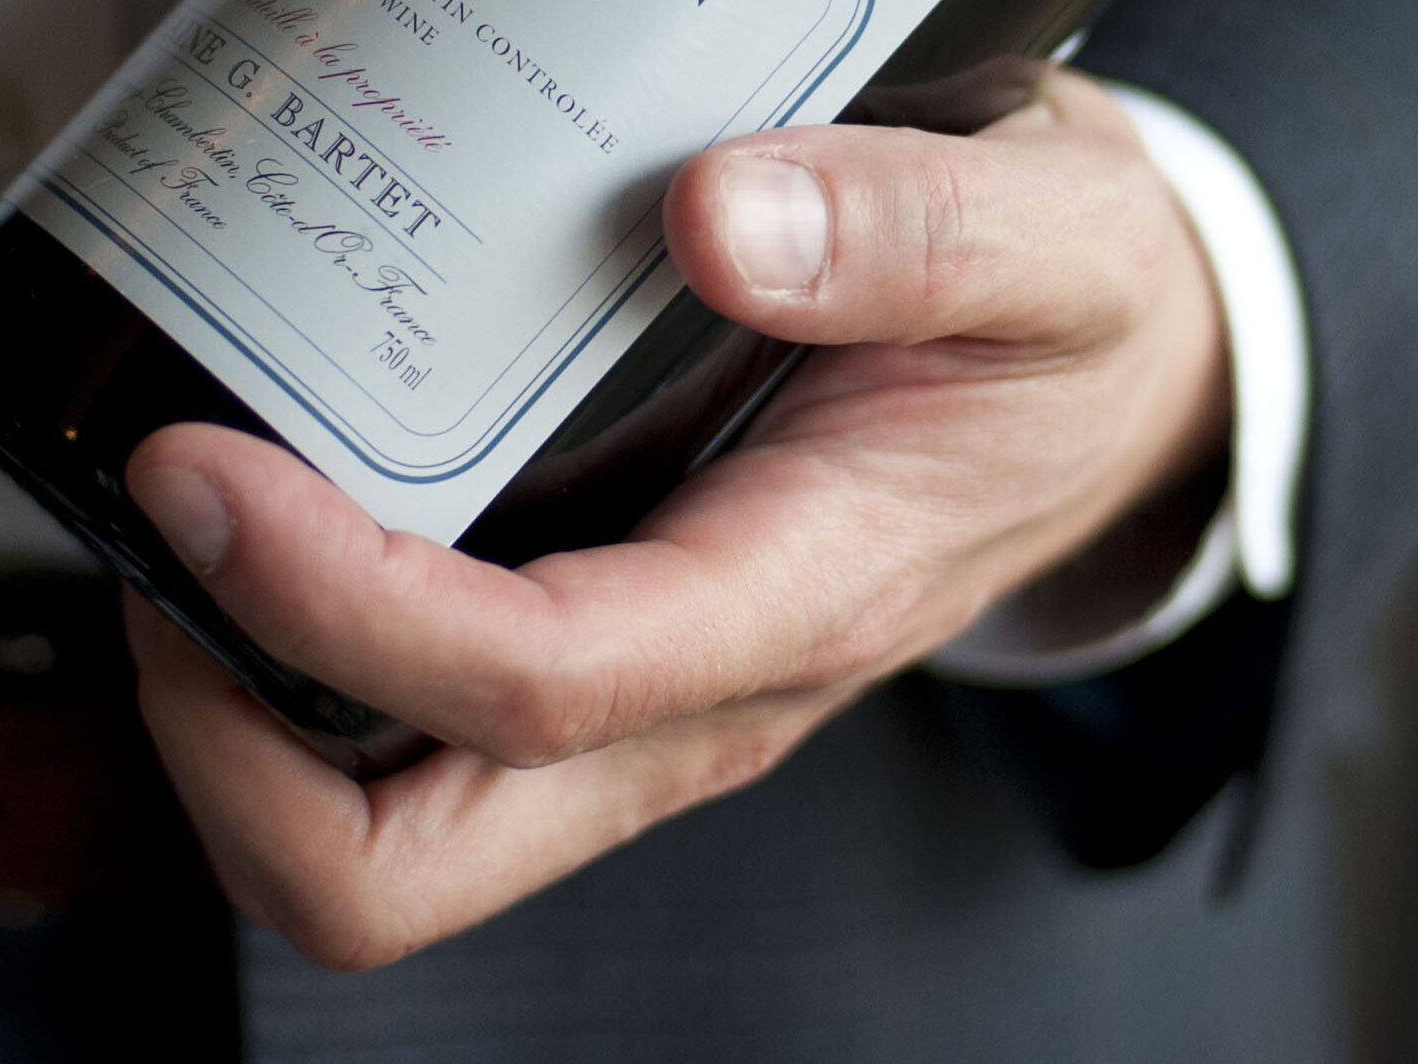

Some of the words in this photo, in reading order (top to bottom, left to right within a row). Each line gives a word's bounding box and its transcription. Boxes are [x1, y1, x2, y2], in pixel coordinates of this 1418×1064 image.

[295, 32, 319, 47] à
[313, 43, 358, 67] la
[318, 68, 452, 153] propriété
[476, 22, 619, 155] CONTROLÉE
[228, 59, 260, 99] G.
[271, 92, 442, 239] BARTET
[130, 158, 180, 175] of
[159, 166, 227, 230] France
[369, 331, 410, 370] 750
[399, 363, 432, 390] ml
